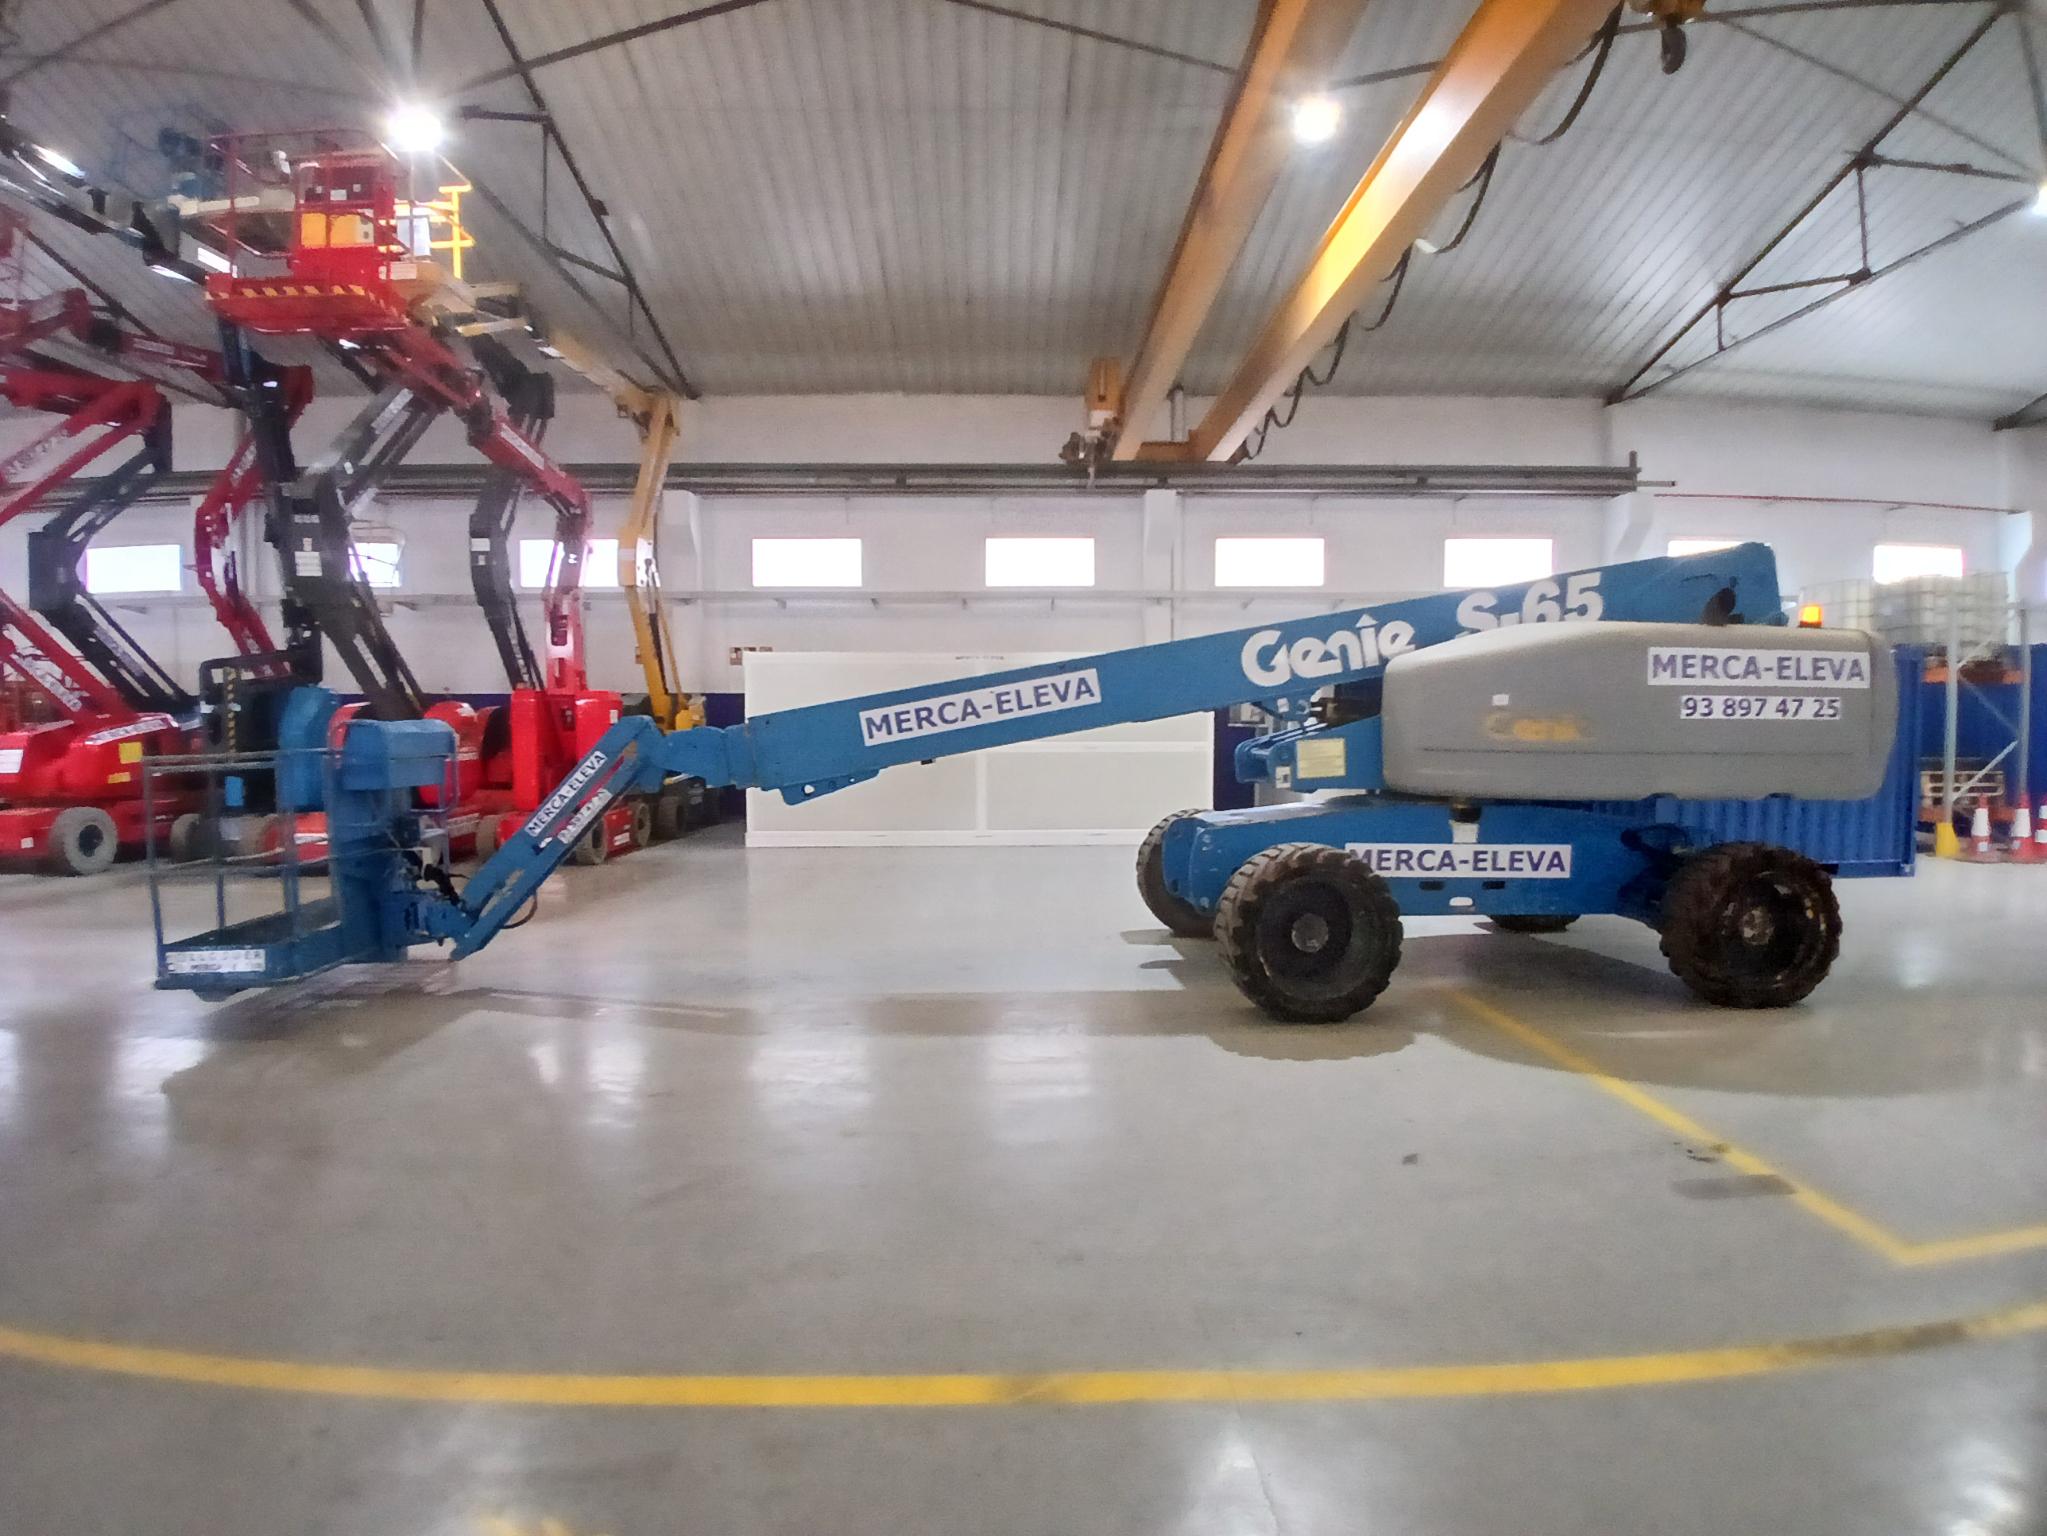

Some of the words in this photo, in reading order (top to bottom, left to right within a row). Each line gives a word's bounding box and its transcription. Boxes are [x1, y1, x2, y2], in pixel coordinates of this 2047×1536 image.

[1241, 613, 1415, 687] Genie
[1456, 571, 1604, 632] S-65
[1652, 654, 1865, 681] MERCA-ELEVA
[864, 676, 1096, 739] MERCA-ELEVA
[1685, 697, 1713, 717] 93
[1722, 698, 1767, 717] 897
[1775, 698, 1803, 718] 47
[1813, 698, 1840, 718] 25
[528, 754, 605, 833] MERCA-ELEVA
